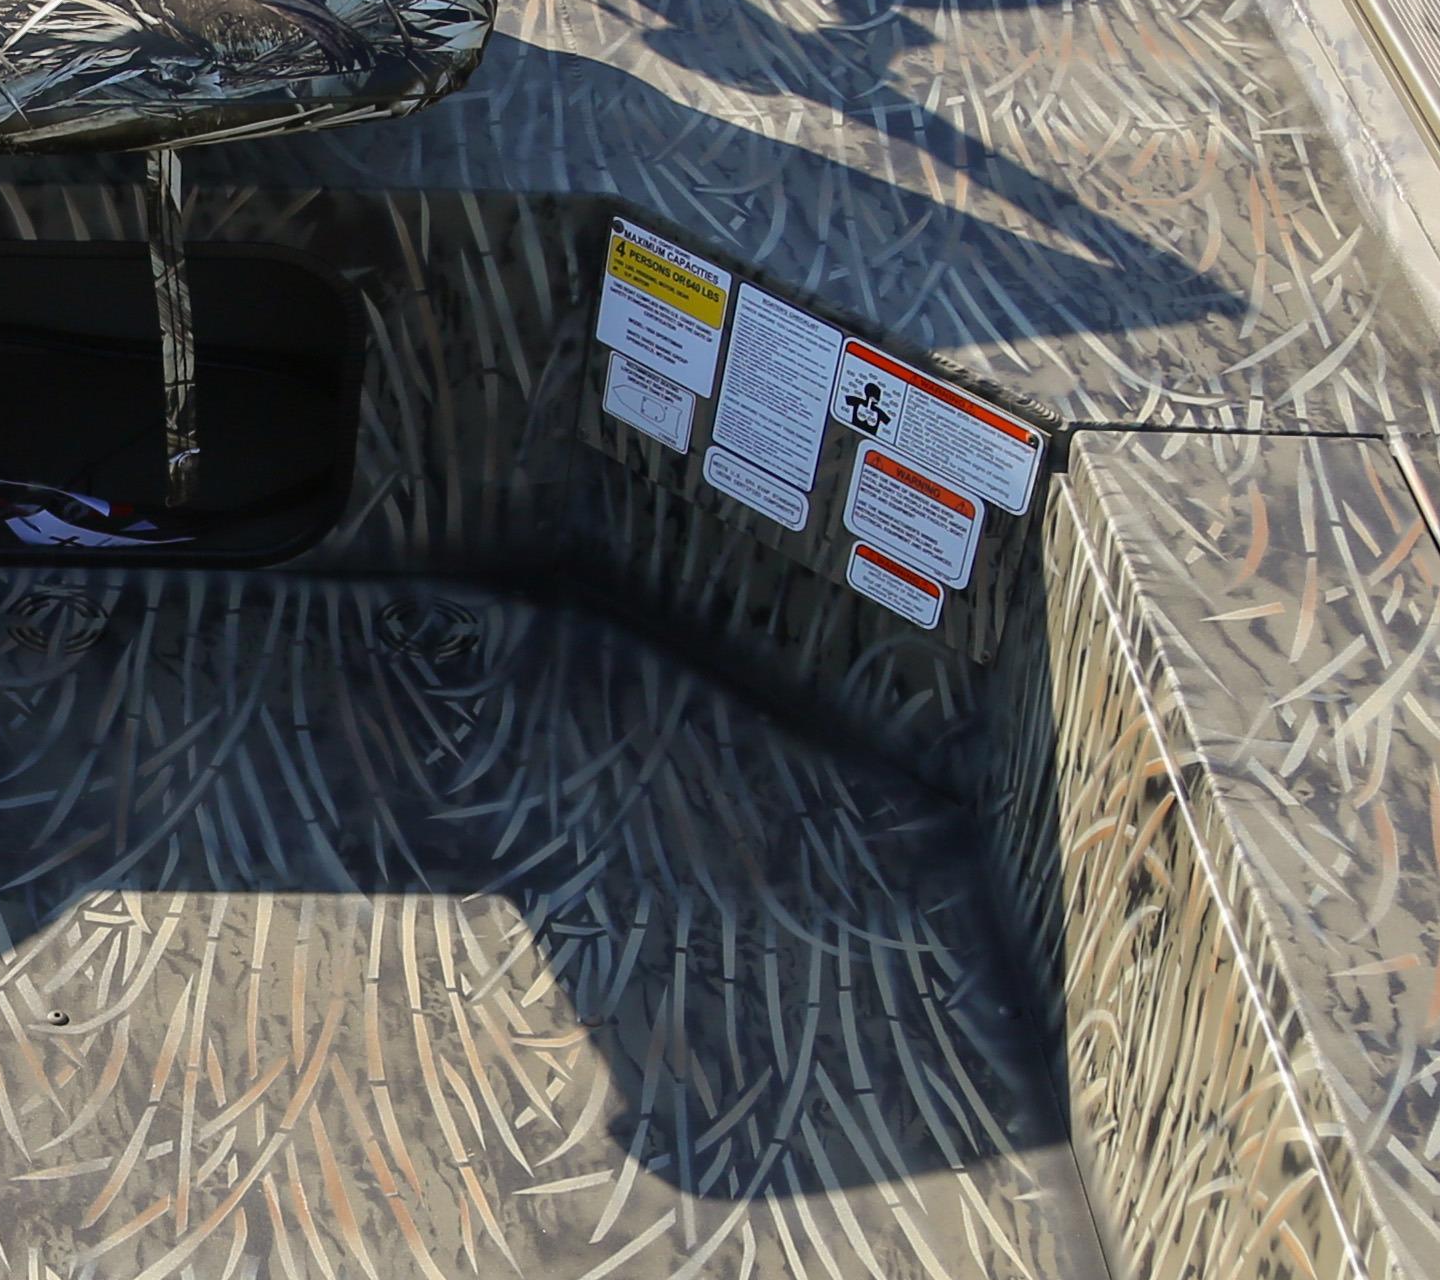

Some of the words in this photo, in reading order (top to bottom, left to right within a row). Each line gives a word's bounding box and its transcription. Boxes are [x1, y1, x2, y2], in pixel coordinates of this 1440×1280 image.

[614, 236, 628, 258] 4
[628, 248, 671, 278] PERSONS
[671, 270, 686, 286] OR
[701, 286, 720, 303] LBS
[622, 228, 666, 258] MAXIMUM
[666, 251, 720, 285] CAPACITIES
[894, 466, 941, 499] WARNING
